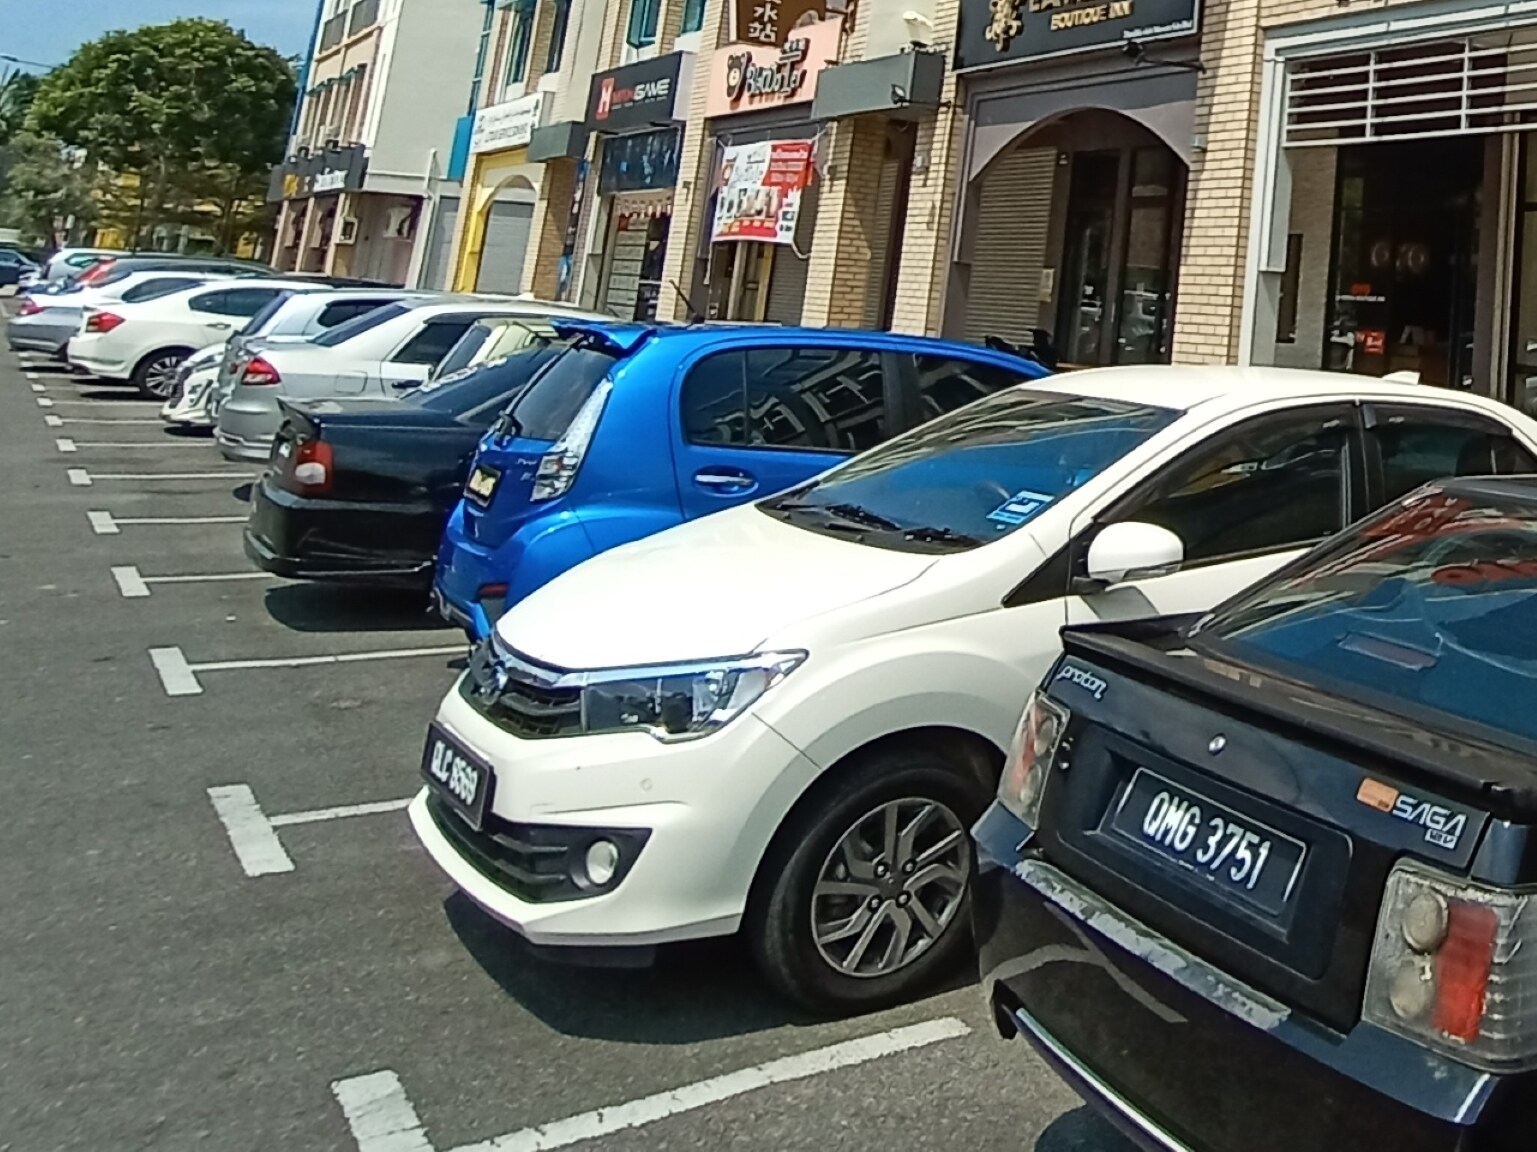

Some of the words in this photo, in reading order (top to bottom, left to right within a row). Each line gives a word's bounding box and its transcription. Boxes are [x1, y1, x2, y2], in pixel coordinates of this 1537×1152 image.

[1050, 5, 1108, 31] BOUTIQUE
[1055, 665, 1107, 699] proton
[1392, 794, 1467, 837] SAGA
[1143, 791, 1201, 852] QMG
[1196, 817, 1271, 890] 3751
